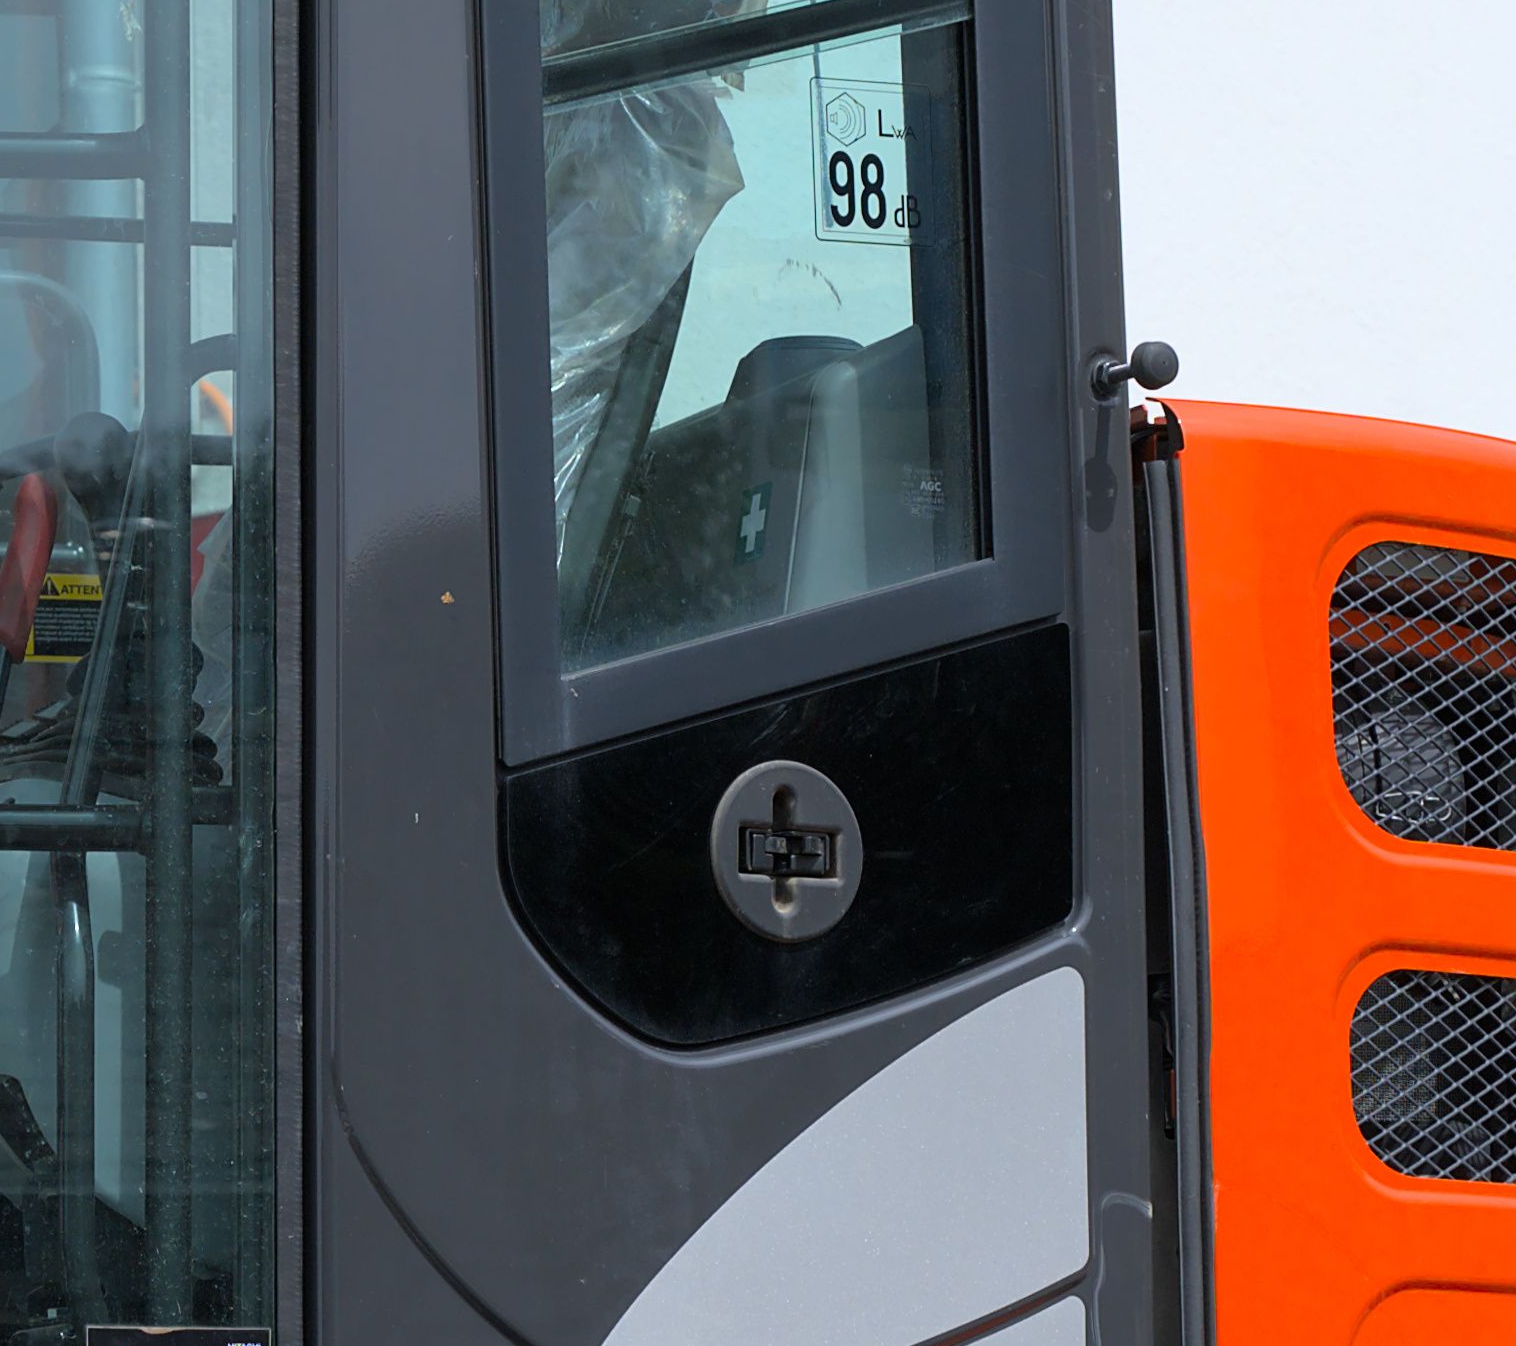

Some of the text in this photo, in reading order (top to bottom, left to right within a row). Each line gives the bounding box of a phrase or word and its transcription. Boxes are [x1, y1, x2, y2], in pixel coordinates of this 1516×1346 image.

[829, 150, 922, 229] 98 dB
[920, 481, 942, 492] AGC
